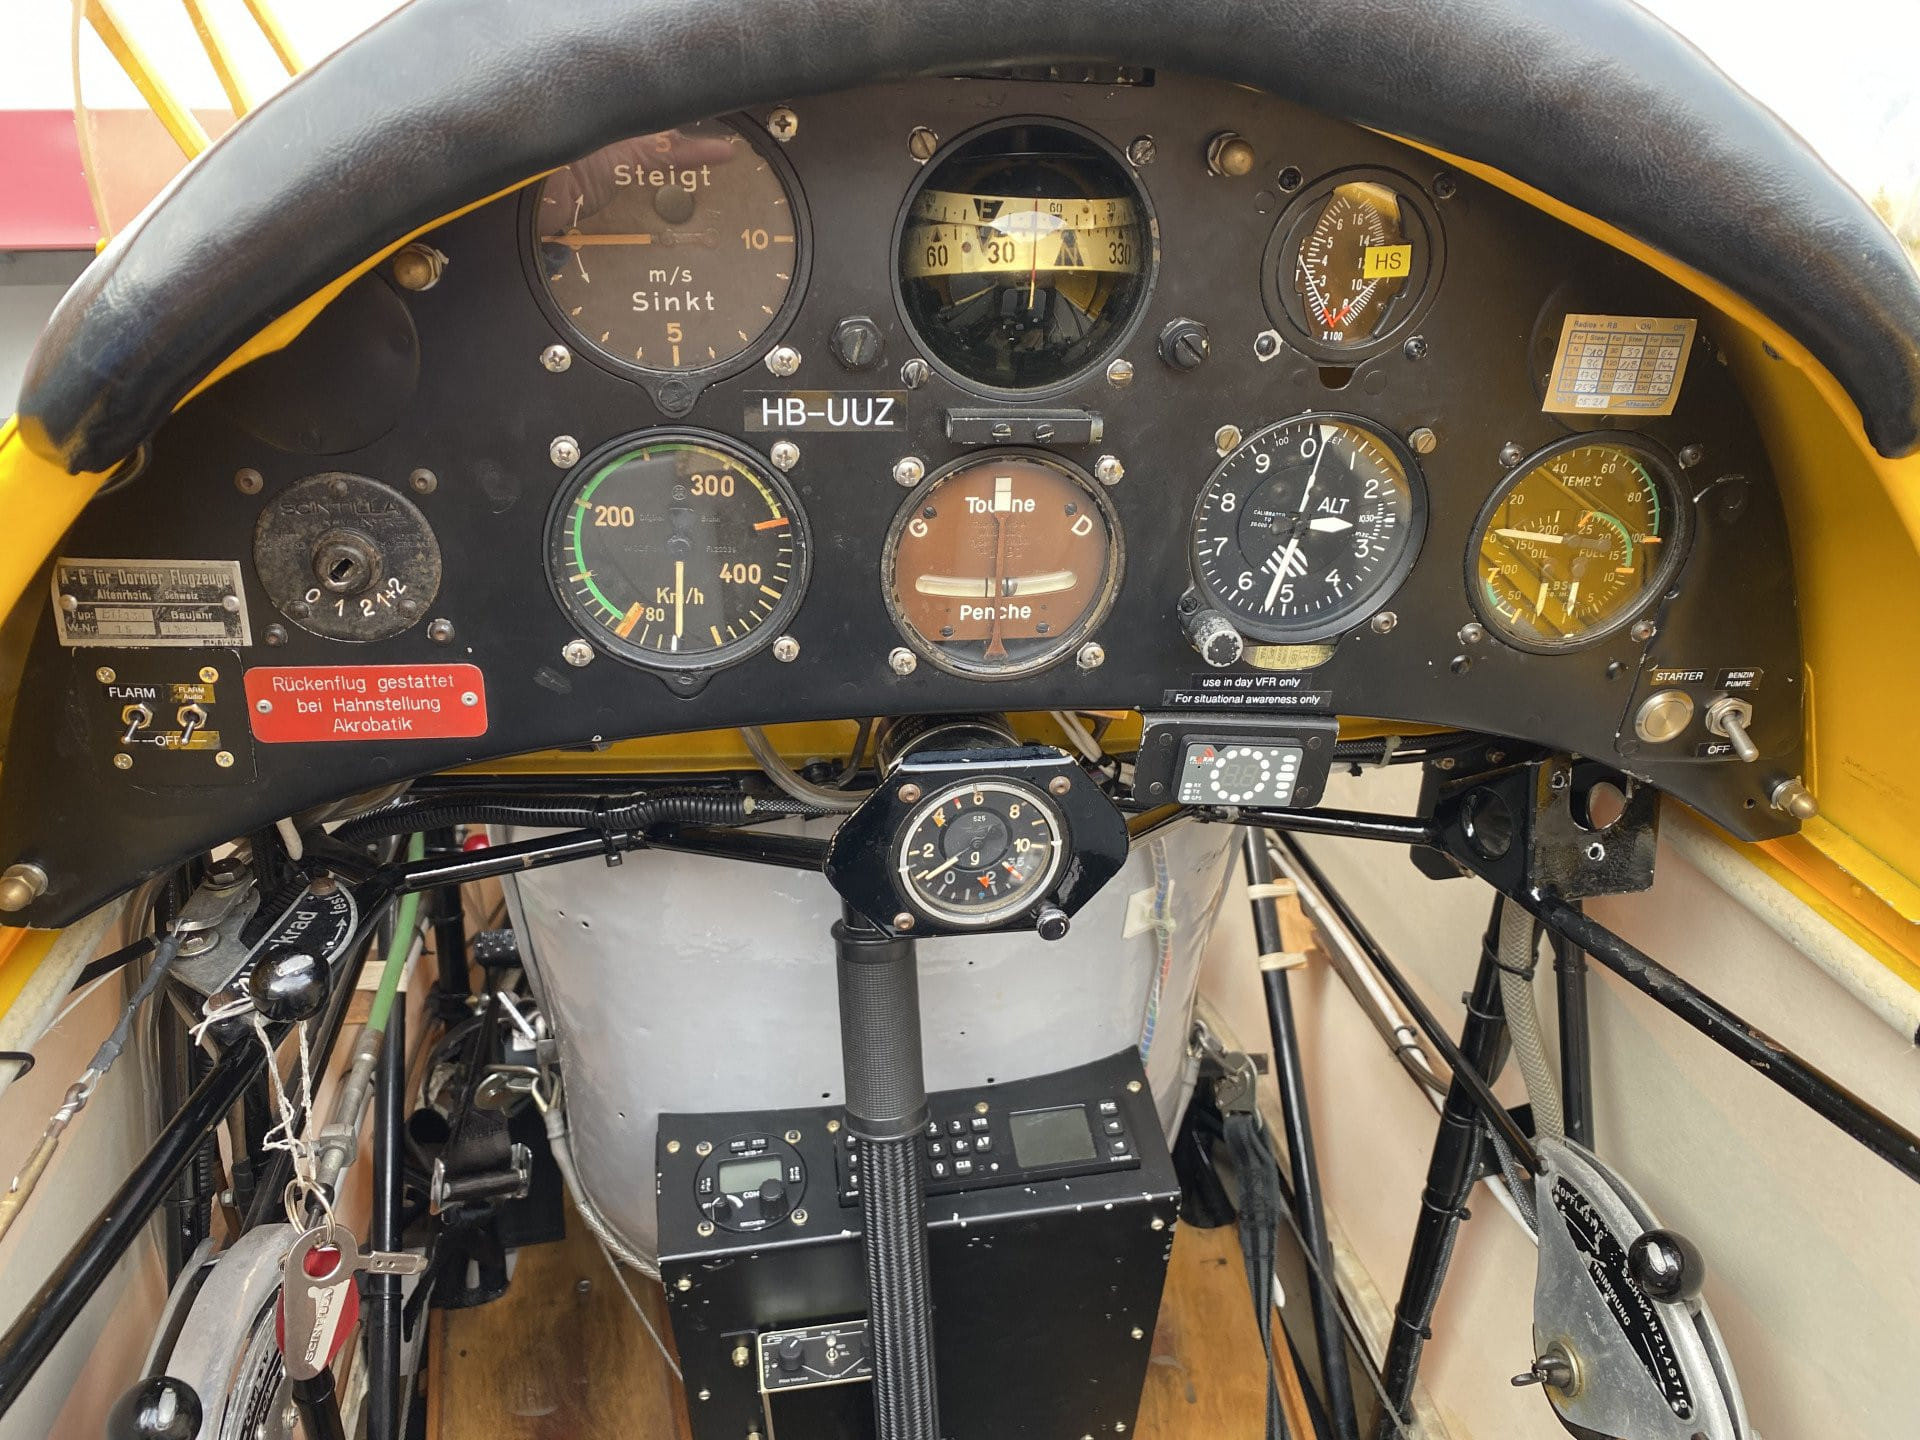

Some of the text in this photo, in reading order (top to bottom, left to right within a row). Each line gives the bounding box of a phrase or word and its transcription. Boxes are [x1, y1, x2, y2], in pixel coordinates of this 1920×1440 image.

[614, 164, 712, 192] Steigt
[1050, 202, 1063, 213] 60
[1336, 218, 1343, 230] 6
[1353, 213, 1364, 226] 16
[741, 229, 769, 250] 10
[1326, 236, 1334, 248] 5
[1359, 234, 1370, 247] 14
[926, 245, 949, 268] 60
[987, 241, 1016, 265] 30
[1108, 242, 1132, 265] 330
[1321, 255, 1328, 267] 4
[1375, 251, 1402, 270] HS
[649, 266, 693, 284] m/s
[1319, 275, 1326, 287] 3
[1351, 278, 1363, 291] 10
[632, 290, 715, 312] Sinkt
[666, 322, 683, 342] 5
[1329, 331, 1343, 341] 100
[762, 397, 895, 427] HB-UUZ
[1275, 436, 1289, 448] 100
[1300, 437, 1317, 459] 0
[1255, 453, 1271, 474] 9
[1552, 463, 1568, 475] 40
[1601, 463, 1616, 474] 60
[690, 474, 735, 498] 300
[1364, 478, 1379, 499] 2
[1220, 493, 1236, 513] 8
[1509, 494, 1525, 505] 20
[1627, 492, 1642, 503] 80
[1317, 497, 1350, 514] ALT
[594, 505, 634, 527] 200
[908, 518, 929, 538] G
[1071, 514, 1093, 536] D
[1538, 524, 1560, 535] 200
[1578, 525, 1593, 535] 25
[1213, 537, 1228, 557] 7
[1354, 538, 1369, 558] 3
[1516, 540, 1535, 550] 150
[1531, 549, 1549, 559] OIL
[1608, 551, 1620, 561] 15
[719, 563, 762, 585] 400
[1501, 564, 1518, 575] 100
[118, 569, 164, 586] Dornier
[169, 568, 230, 588] Flugzeuge
[1238, 572, 1253, 591] 6
[1325, 569, 1341, 587] 4
[1603, 573, 1614, 582] 10
[305, 588, 320, 604] 0
[1279, 584, 1294, 604] 5
[1508, 590, 1522, 600] 50
[1587, 592, 1595, 603] 5
[334, 599, 345, 617] 1
[359, 598, 376, 618] 2
[645, 607, 665, 622] 80
[960, 604, 1032, 622] Penche
[170, 610, 213, 621] Baujahr
[1202, 677, 1301, 688] use in day VFR only
[1655, 671, 1704, 682] STARTER
[1727, 671, 1755, 680] BENZIN
[272, 673, 456, 693] Rückenflug gestattet
[1725, 680, 1752, 688] PUMPE
[108, 686, 156, 699] FLARM
[183, 692, 203, 700] Audio
[1175, 693, 1321, 705] For situational awareness only
[296, 697, 441, 714] bei Hahnstellung
[332, 717, 413, 733] Akrobatik
[1707, 744, 1731, 756] OFF
[973, 792, 984, 806] 6
[1009, 804, 1020, 819] 8
[923, 843, 935, 858] 2
[1013, 838, 1031, 853] 10
[970, 851, 980, 865] g
[944, 871, 956, 884] 0
[929, 1121, 938, 1132] 2
[953, 1120, 961, 1130] 3
[932, 1143, 941, 1152] 5
[1592, 1263, 1631, 1327] TRIMMUNG
